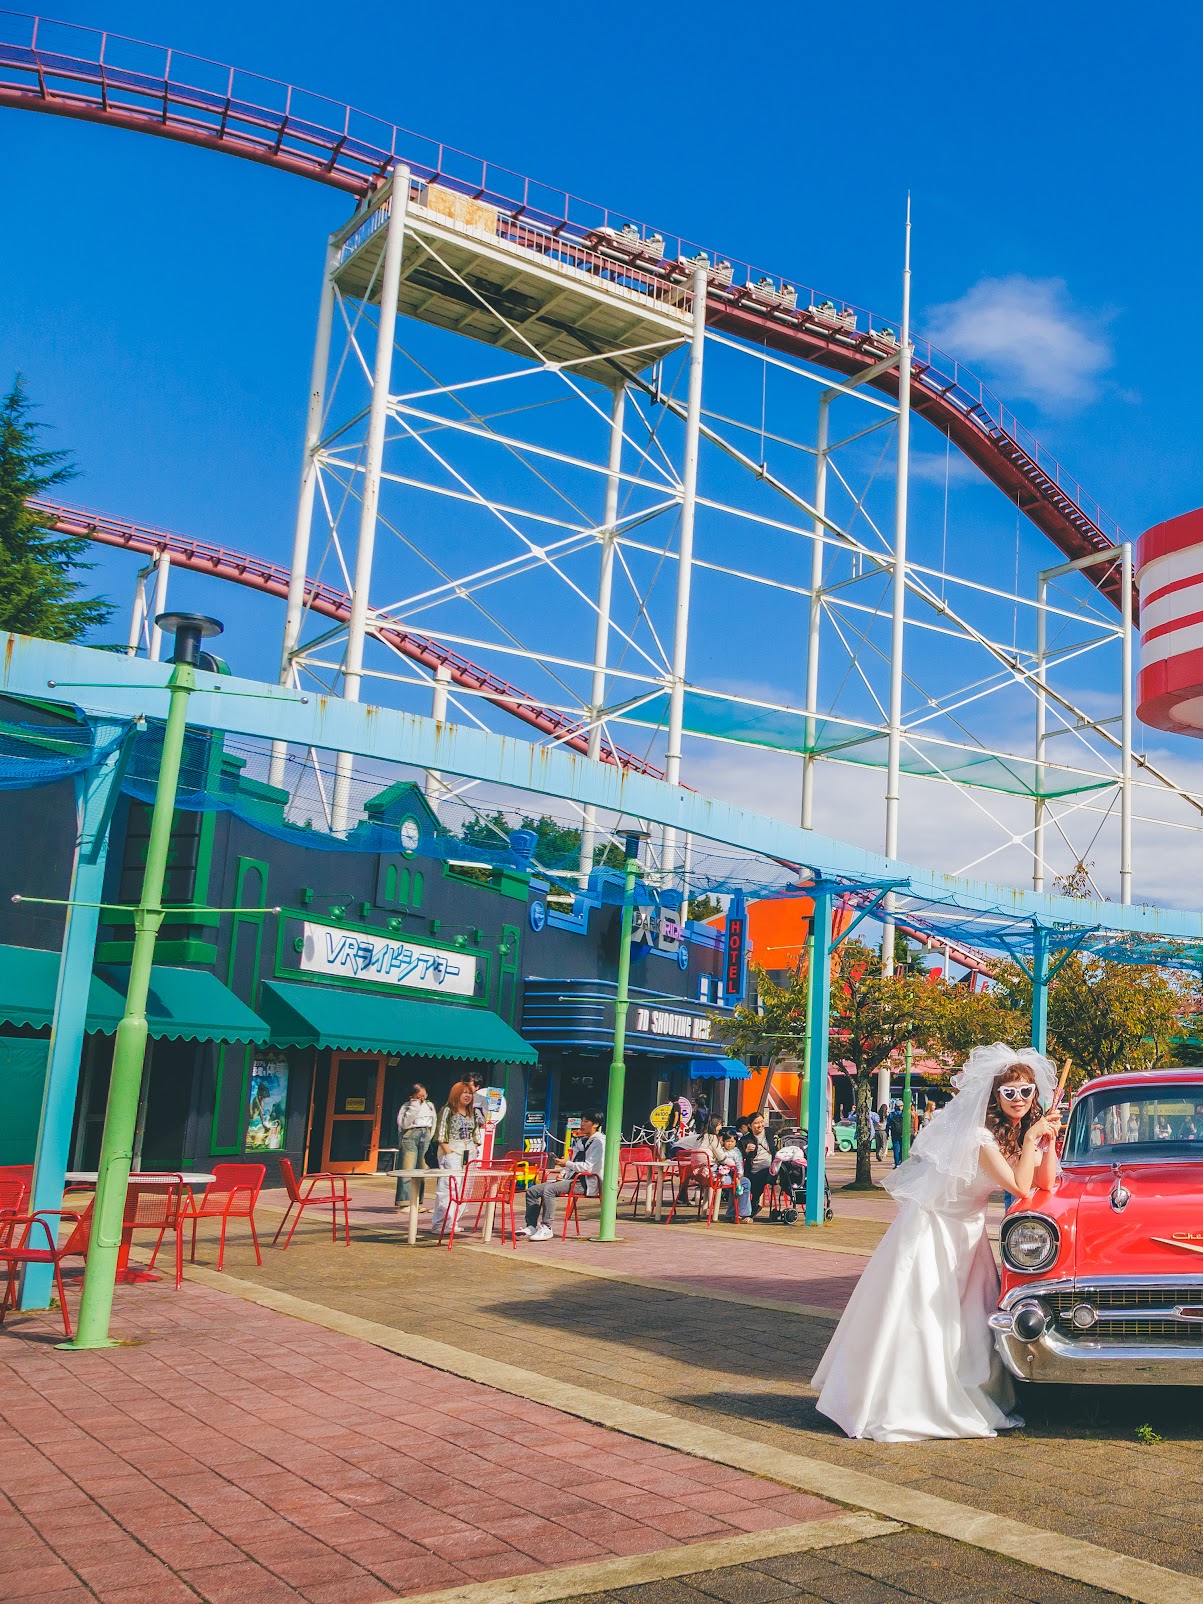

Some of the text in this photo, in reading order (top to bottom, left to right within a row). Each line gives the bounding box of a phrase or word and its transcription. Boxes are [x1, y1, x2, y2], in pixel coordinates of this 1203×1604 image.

[632, 910, 685, 941] DARK RIDE
[325, 932, 461, 985] VRライドシアター
[728, 921, 740, 993] HOTEL
[636, 1008, 712, 1040] 7D SHOOTING RIDE
